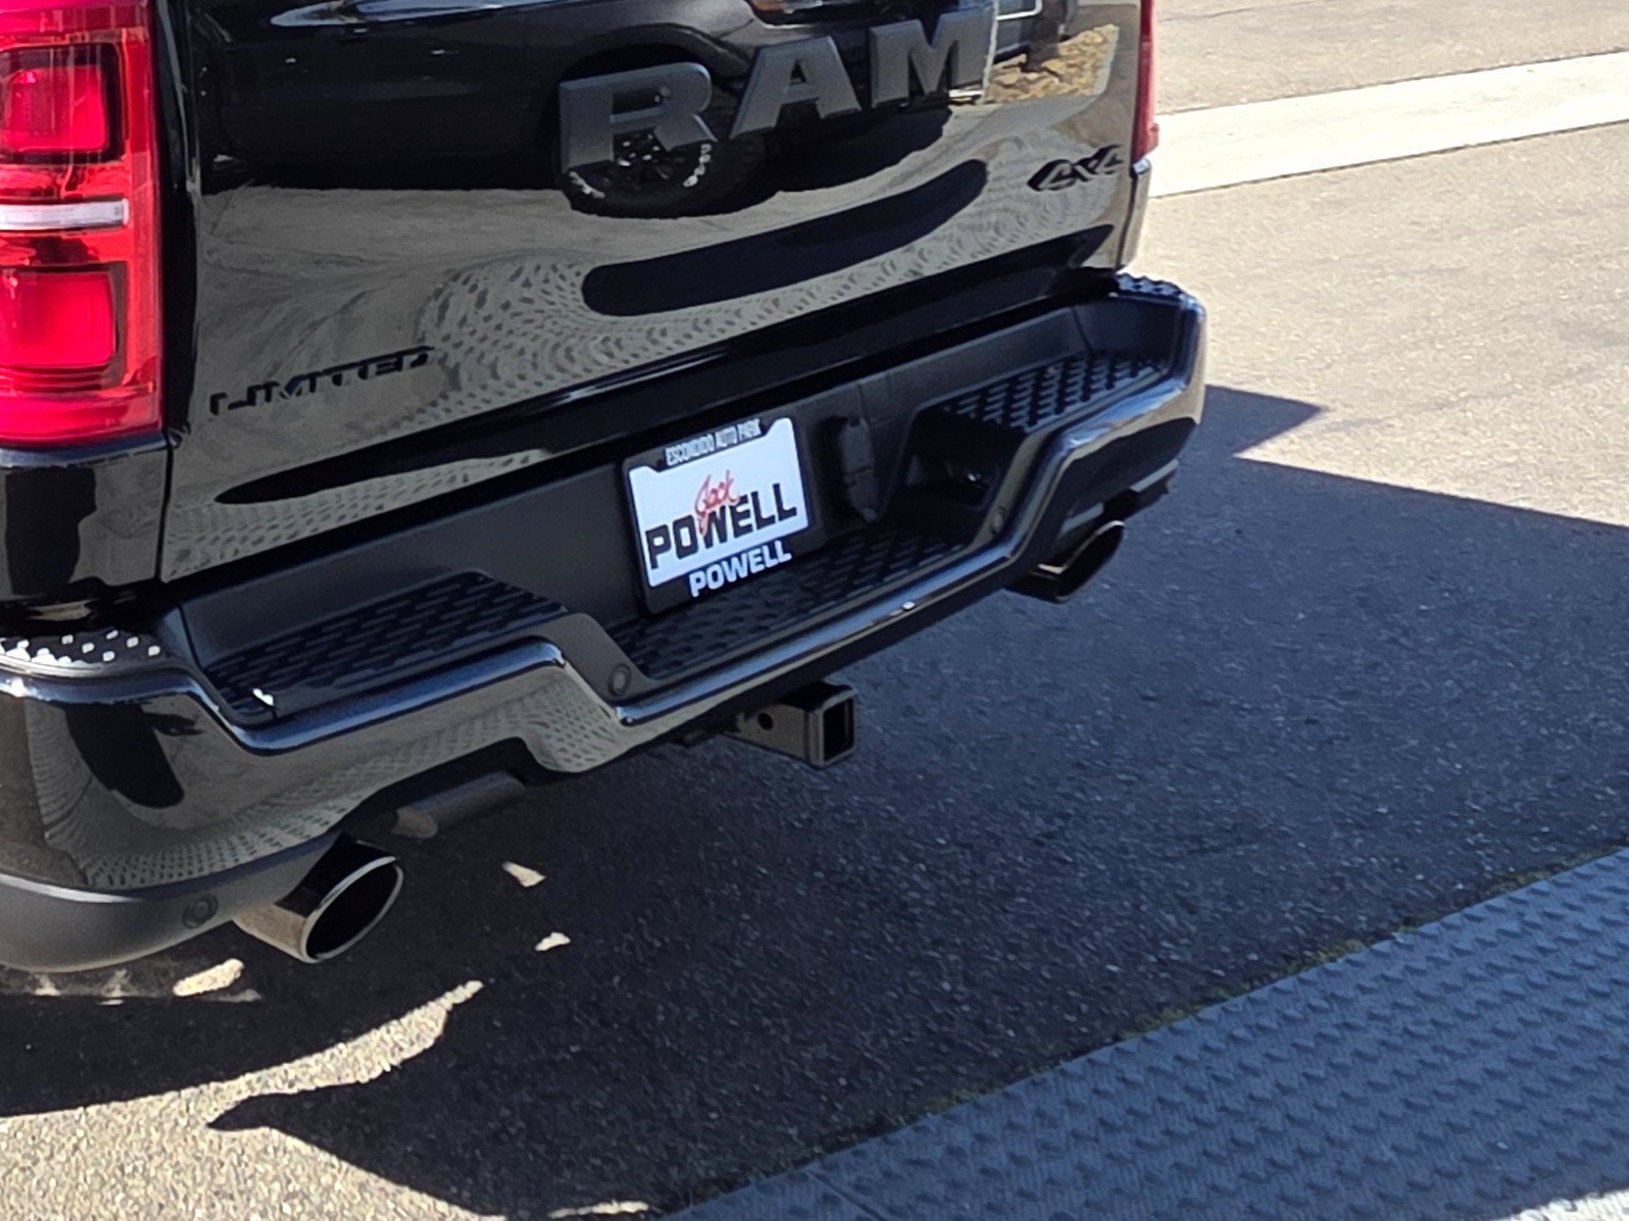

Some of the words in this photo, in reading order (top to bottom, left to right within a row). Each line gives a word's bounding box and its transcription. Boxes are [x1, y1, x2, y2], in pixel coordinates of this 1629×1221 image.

[558, 8, 991, 172] RAM
[209, 345, 437, 415] LIMITED
[645, 483, 797, 569] POWELL
[689, 540, 792, 597] POWELL
